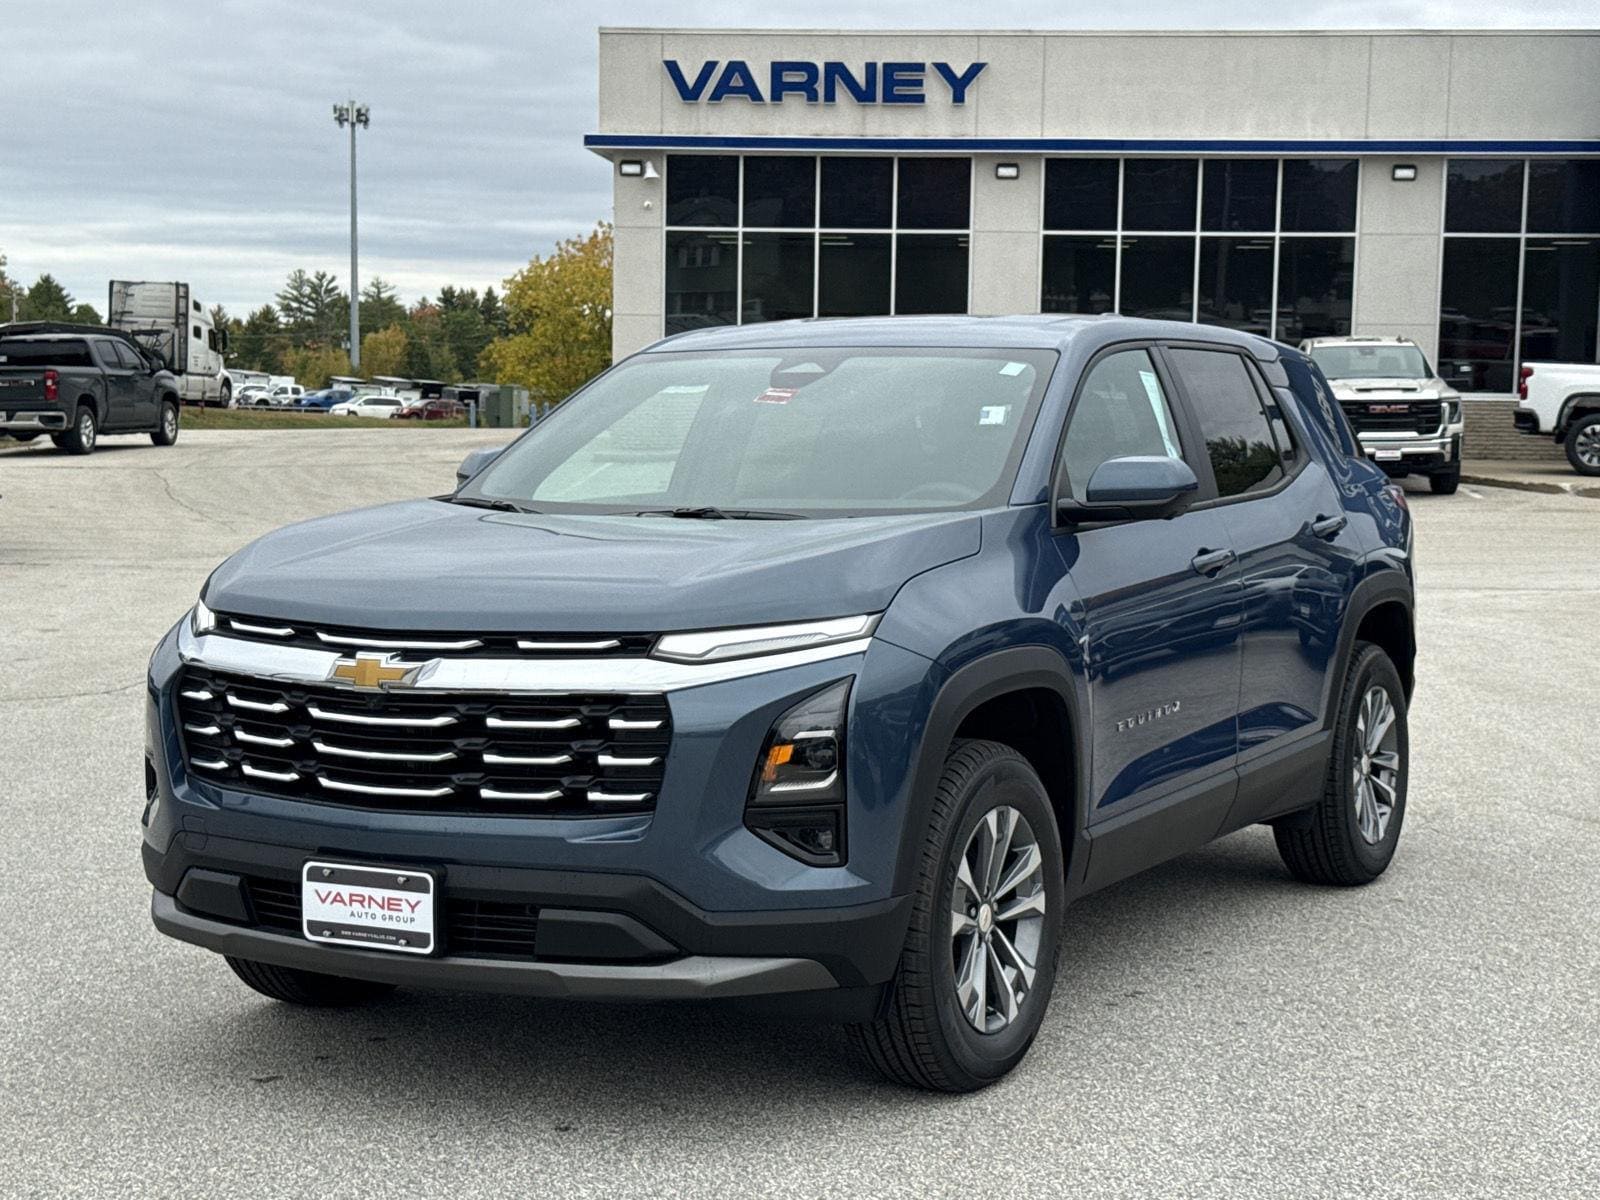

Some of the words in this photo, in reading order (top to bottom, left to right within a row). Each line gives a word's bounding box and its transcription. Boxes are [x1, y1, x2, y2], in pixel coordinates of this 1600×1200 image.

[662, 60, 988, 104] VARNEY
[315, 889, 422, 913] VARNEY
[350, 911, 377, 920] AUTO
[381, 914, 416, 924] GROUP
